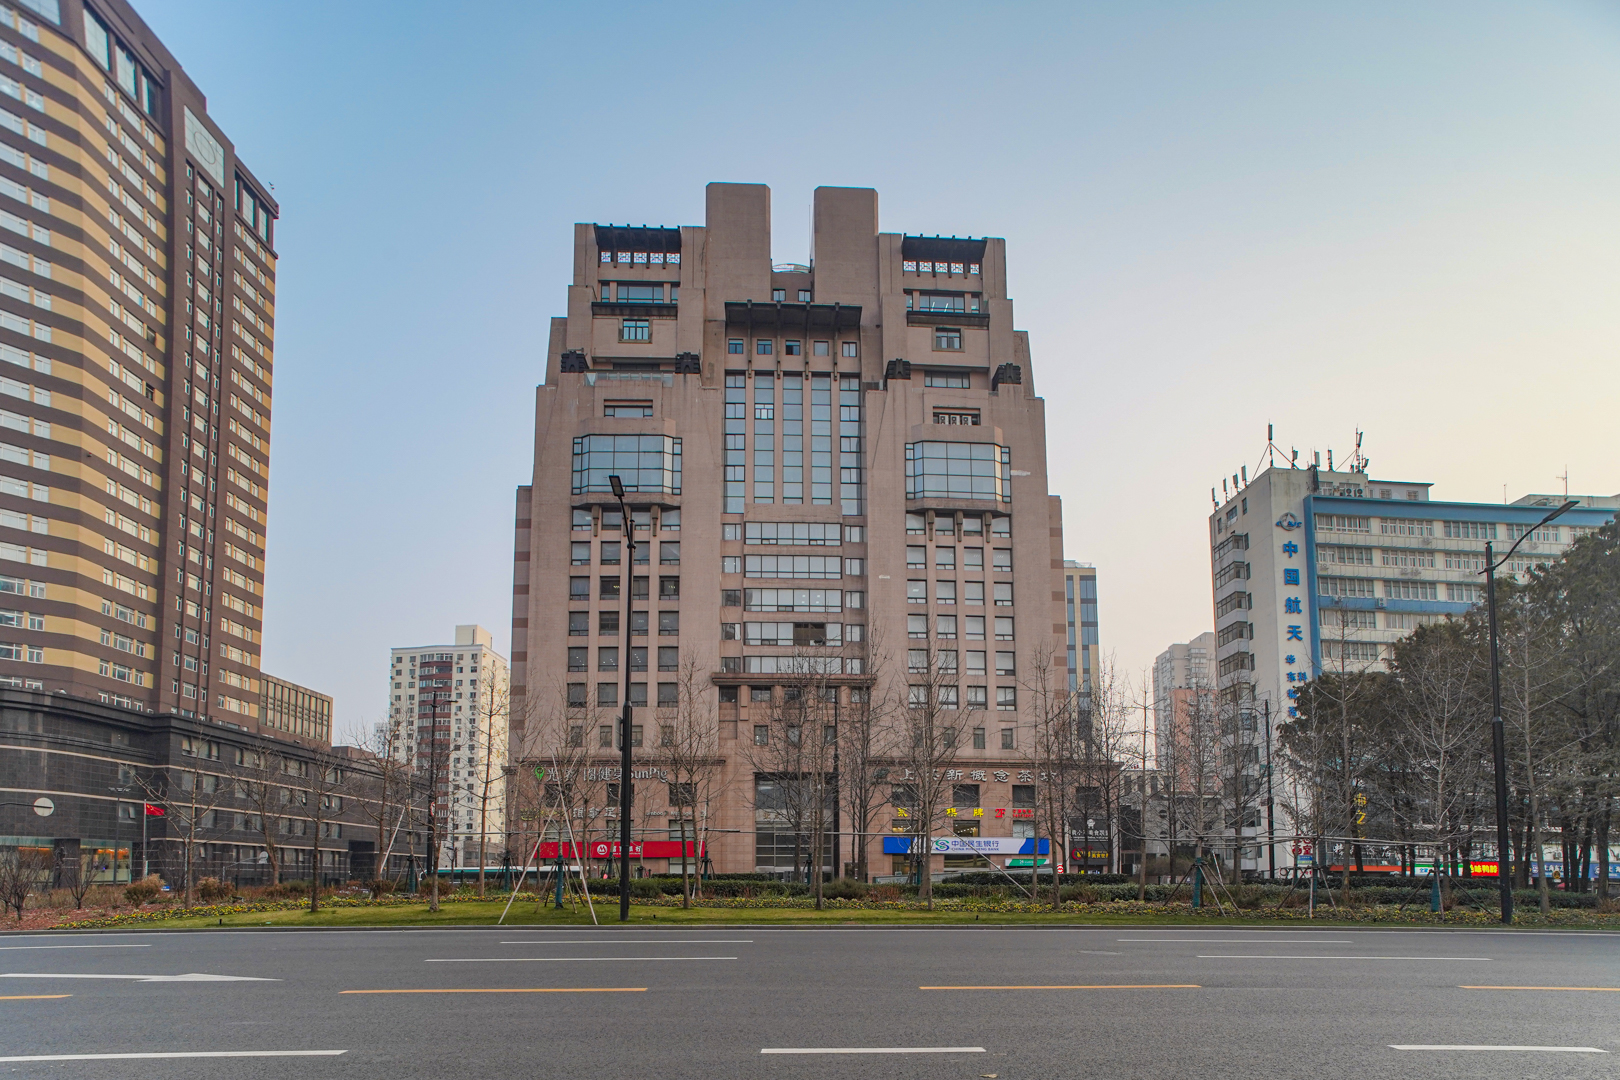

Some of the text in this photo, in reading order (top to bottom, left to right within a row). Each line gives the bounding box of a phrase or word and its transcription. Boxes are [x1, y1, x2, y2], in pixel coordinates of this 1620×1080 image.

[1283, 540, 1303, 642] 中国航天
[994, 808, 1006, 818] 2F
[951, 839, 1000, 849] 中国民生银行
